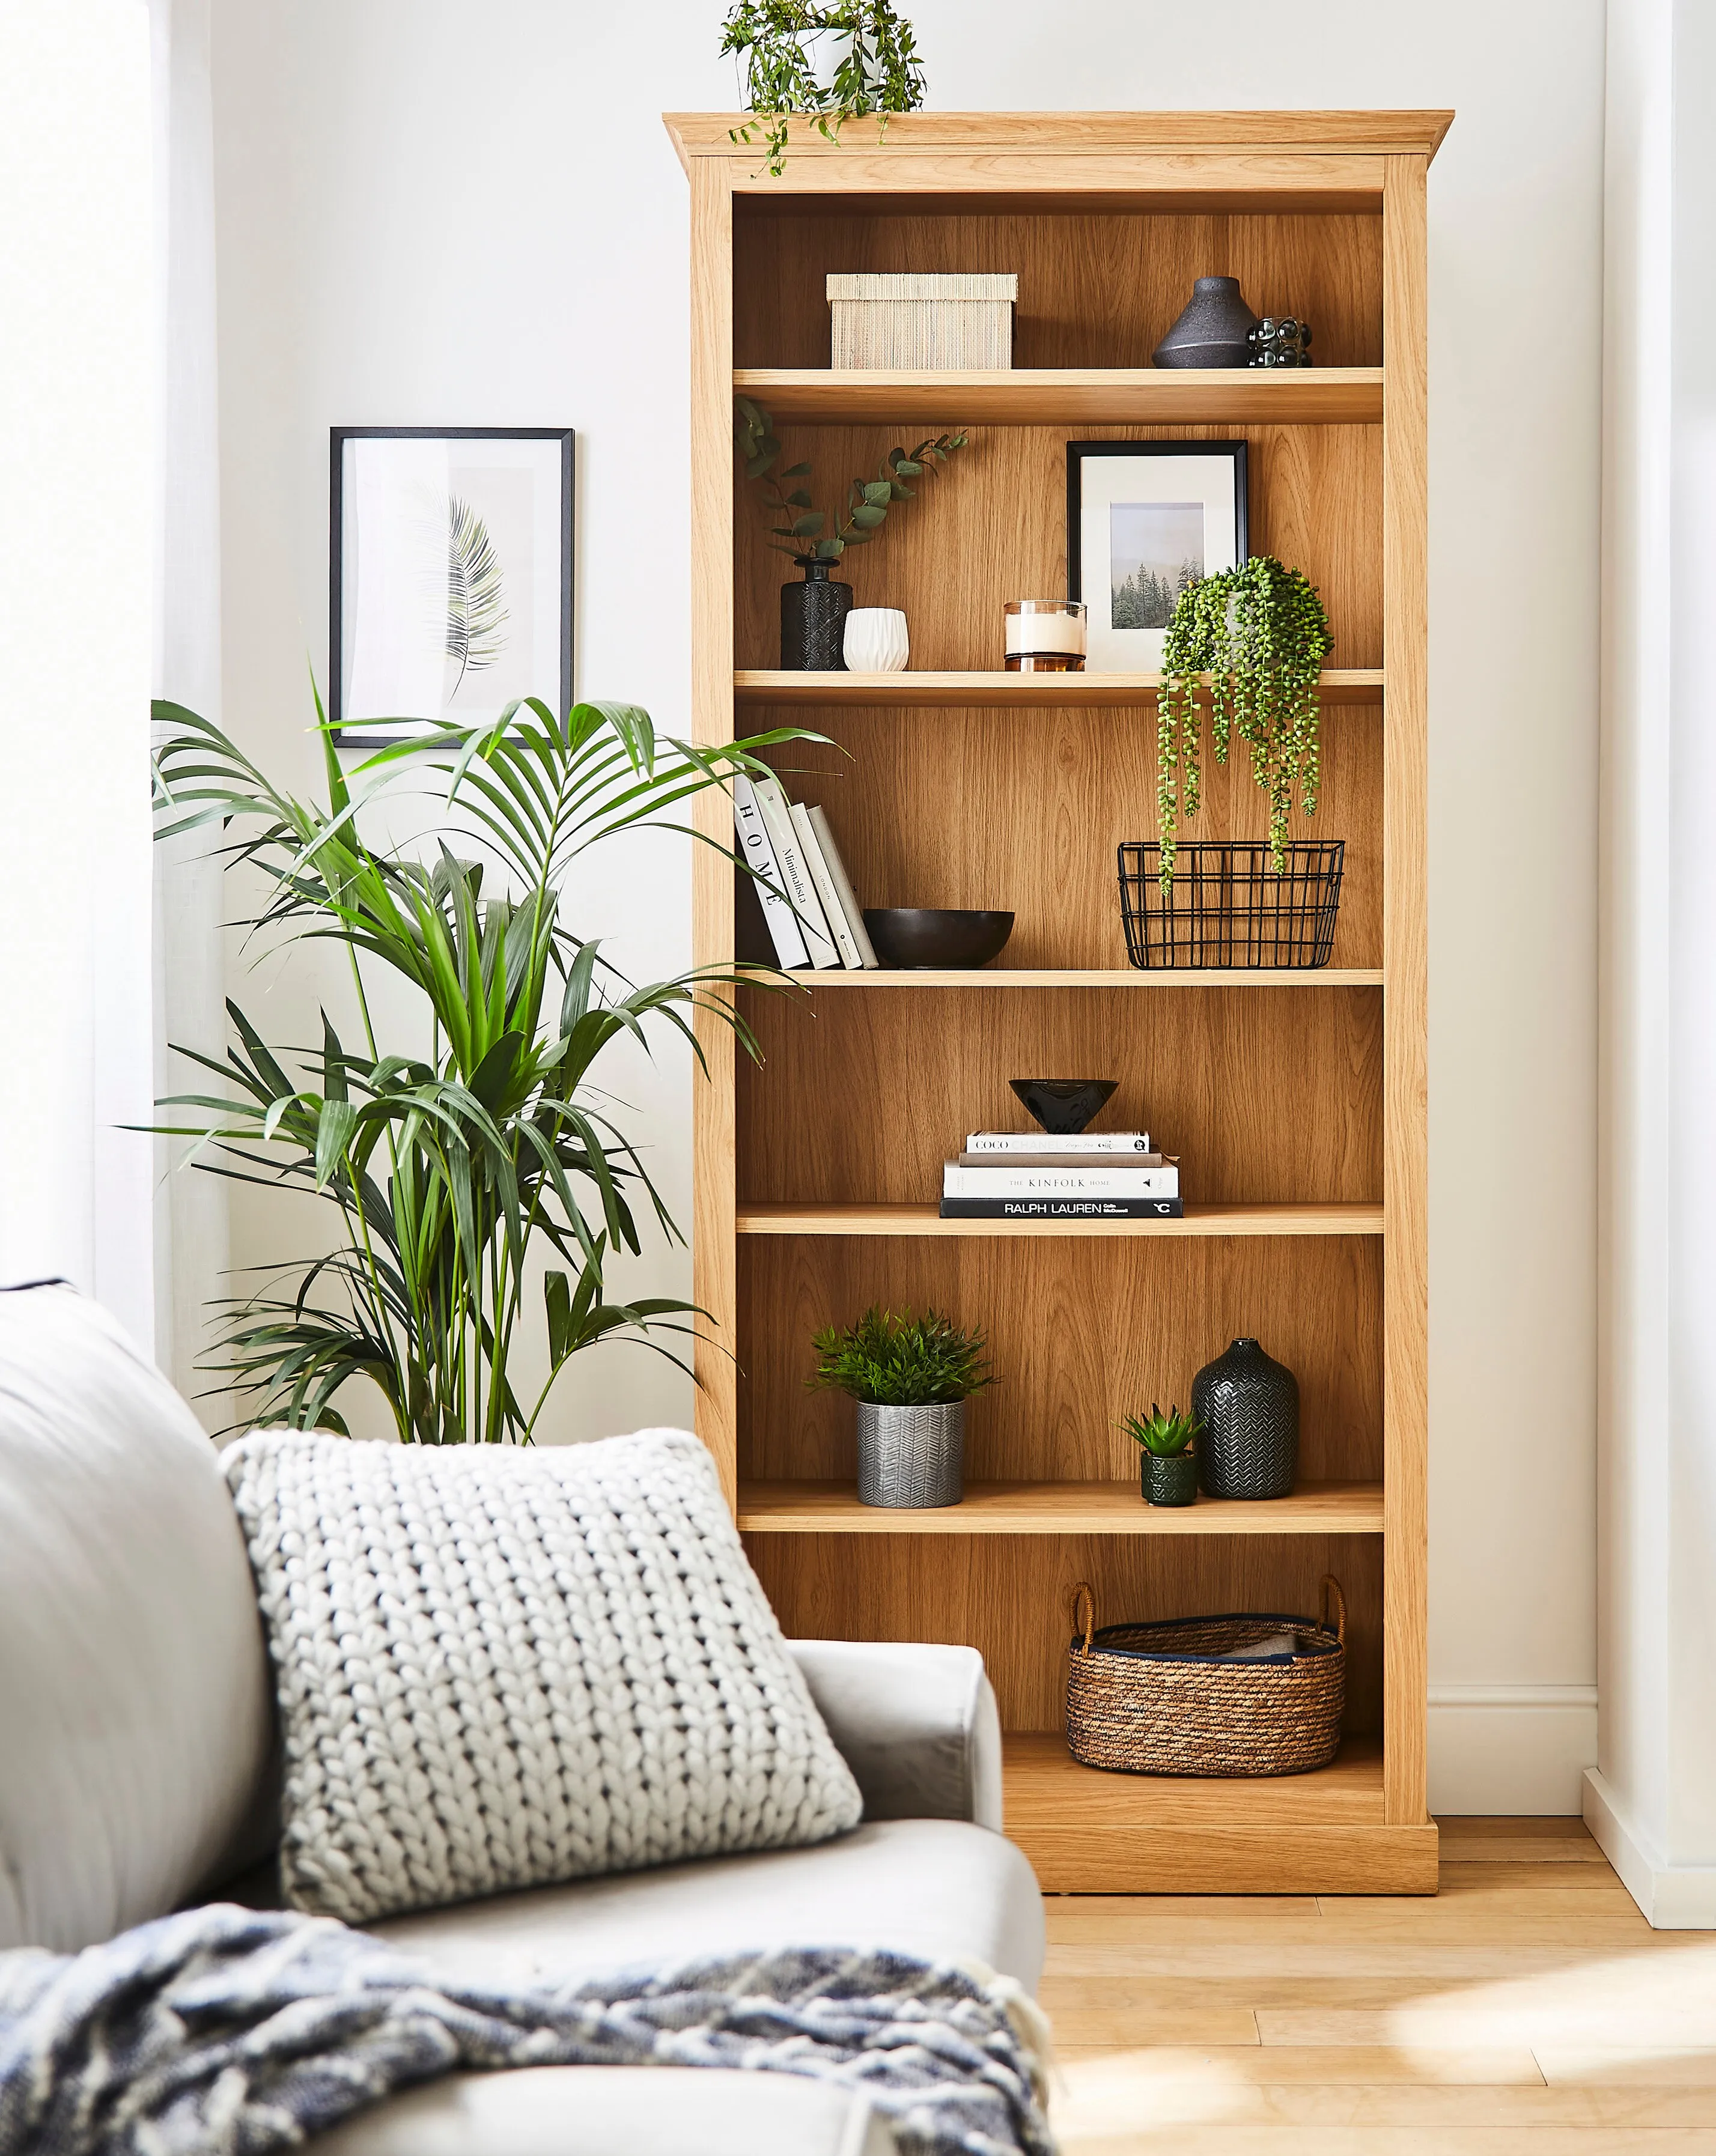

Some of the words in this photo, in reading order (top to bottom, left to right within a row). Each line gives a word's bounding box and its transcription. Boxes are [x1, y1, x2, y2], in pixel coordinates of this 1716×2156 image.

[740, 804, 782, 905] HOME
[782, 848, 806, 903] Minimalista
[819, 875, 831, 899] LONDON
[976, 1140, 1009, 1149] COCO
[1012, 1141, 1062, 1150] CHANEL
[1005, 1203, 1047, 1213] RALPH
[1051, 1203, 1102, 1213] LAUREN
